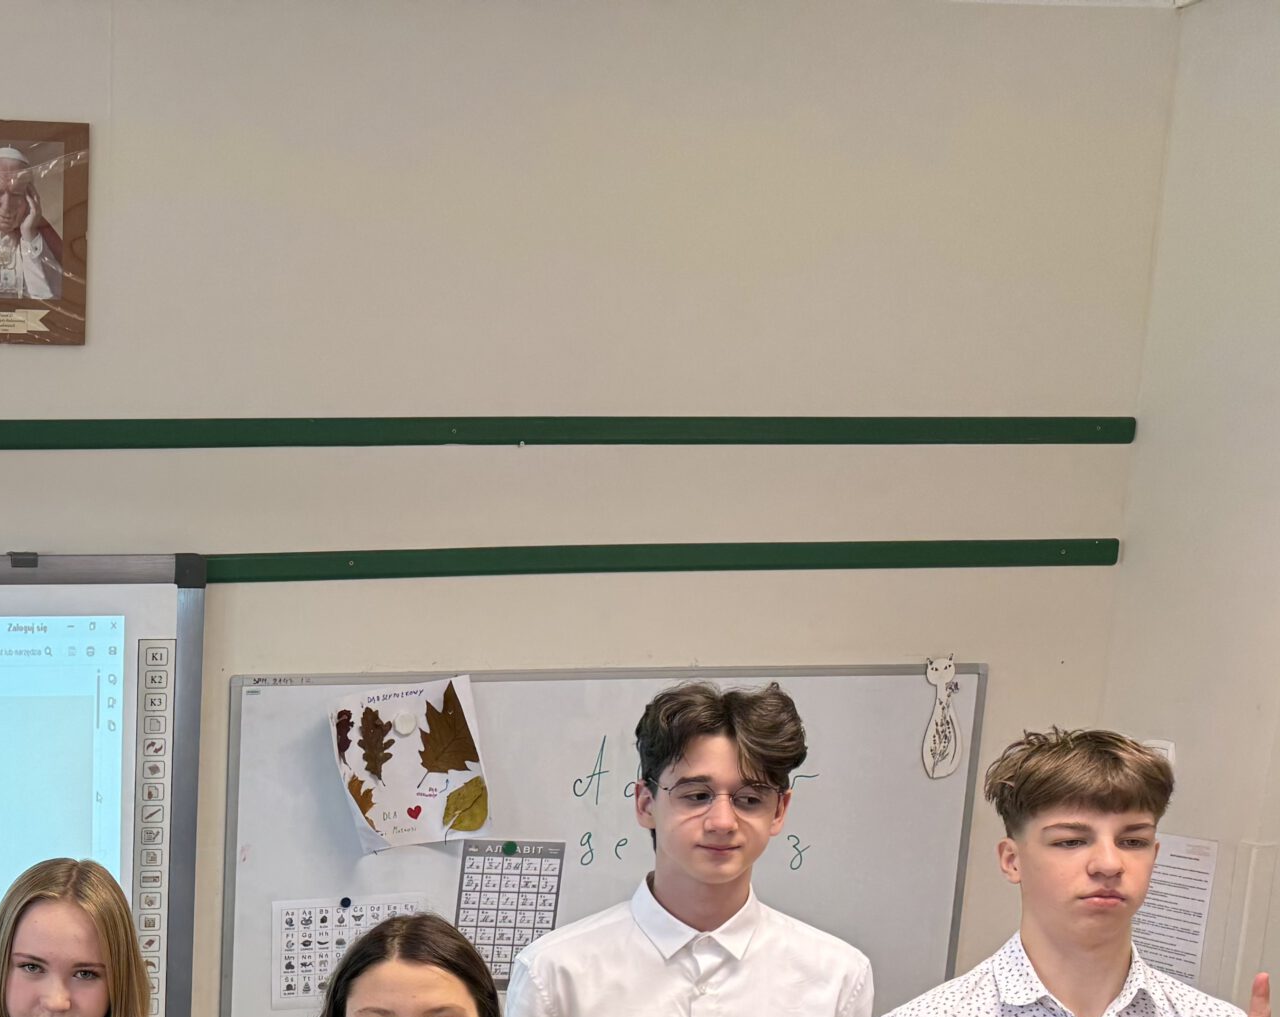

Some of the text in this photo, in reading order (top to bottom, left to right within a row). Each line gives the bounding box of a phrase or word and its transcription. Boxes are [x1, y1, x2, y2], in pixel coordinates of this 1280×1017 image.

[151, 652, 163, 662] K1
[150, 675, 163, 685] K2
[149, 698, 162, 707] K3
[485, 844, 544, 855] АЛАВІТ
